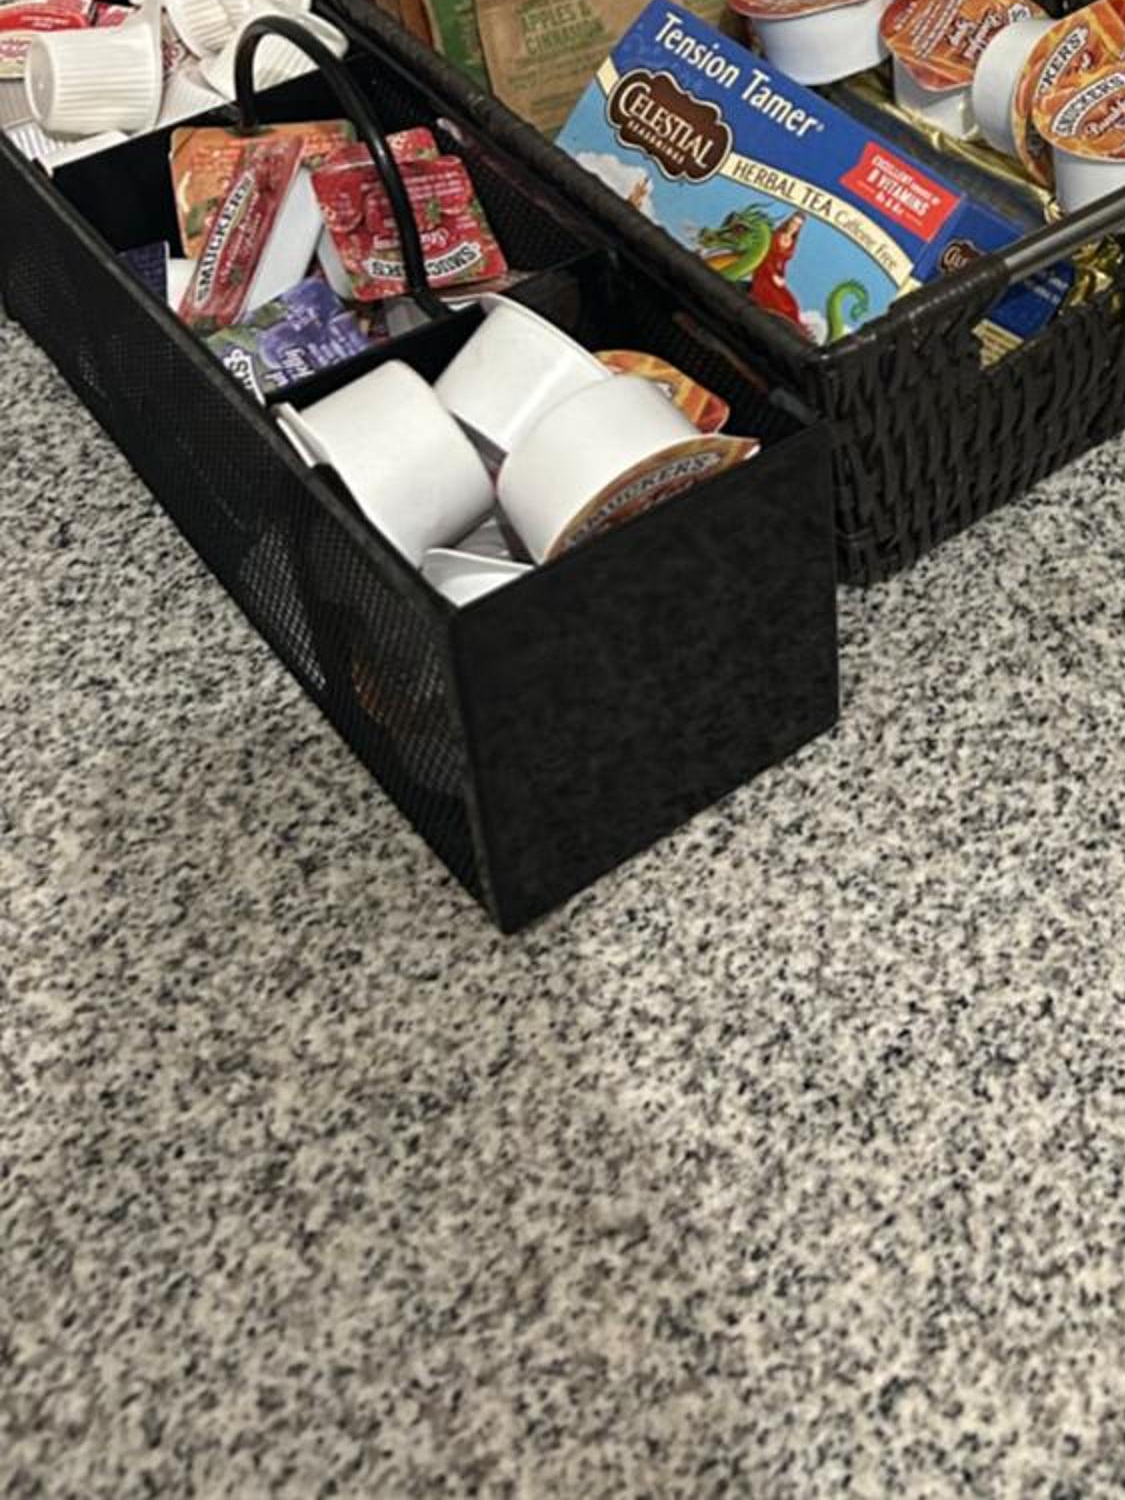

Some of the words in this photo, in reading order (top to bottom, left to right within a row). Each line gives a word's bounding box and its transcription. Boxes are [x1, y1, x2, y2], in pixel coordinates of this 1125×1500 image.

[520, 4, 576, 33] APPLES
[656, 12, 741, 89] Tension
[741, 68, 819, 137] Tamer
[619, 81, 716, 170] CELESTIAL
[732, 159, 797, 200] HERBAL
[801, 188, 833, 218] TEA
[877, 172, 931, 218] VITAMINS
